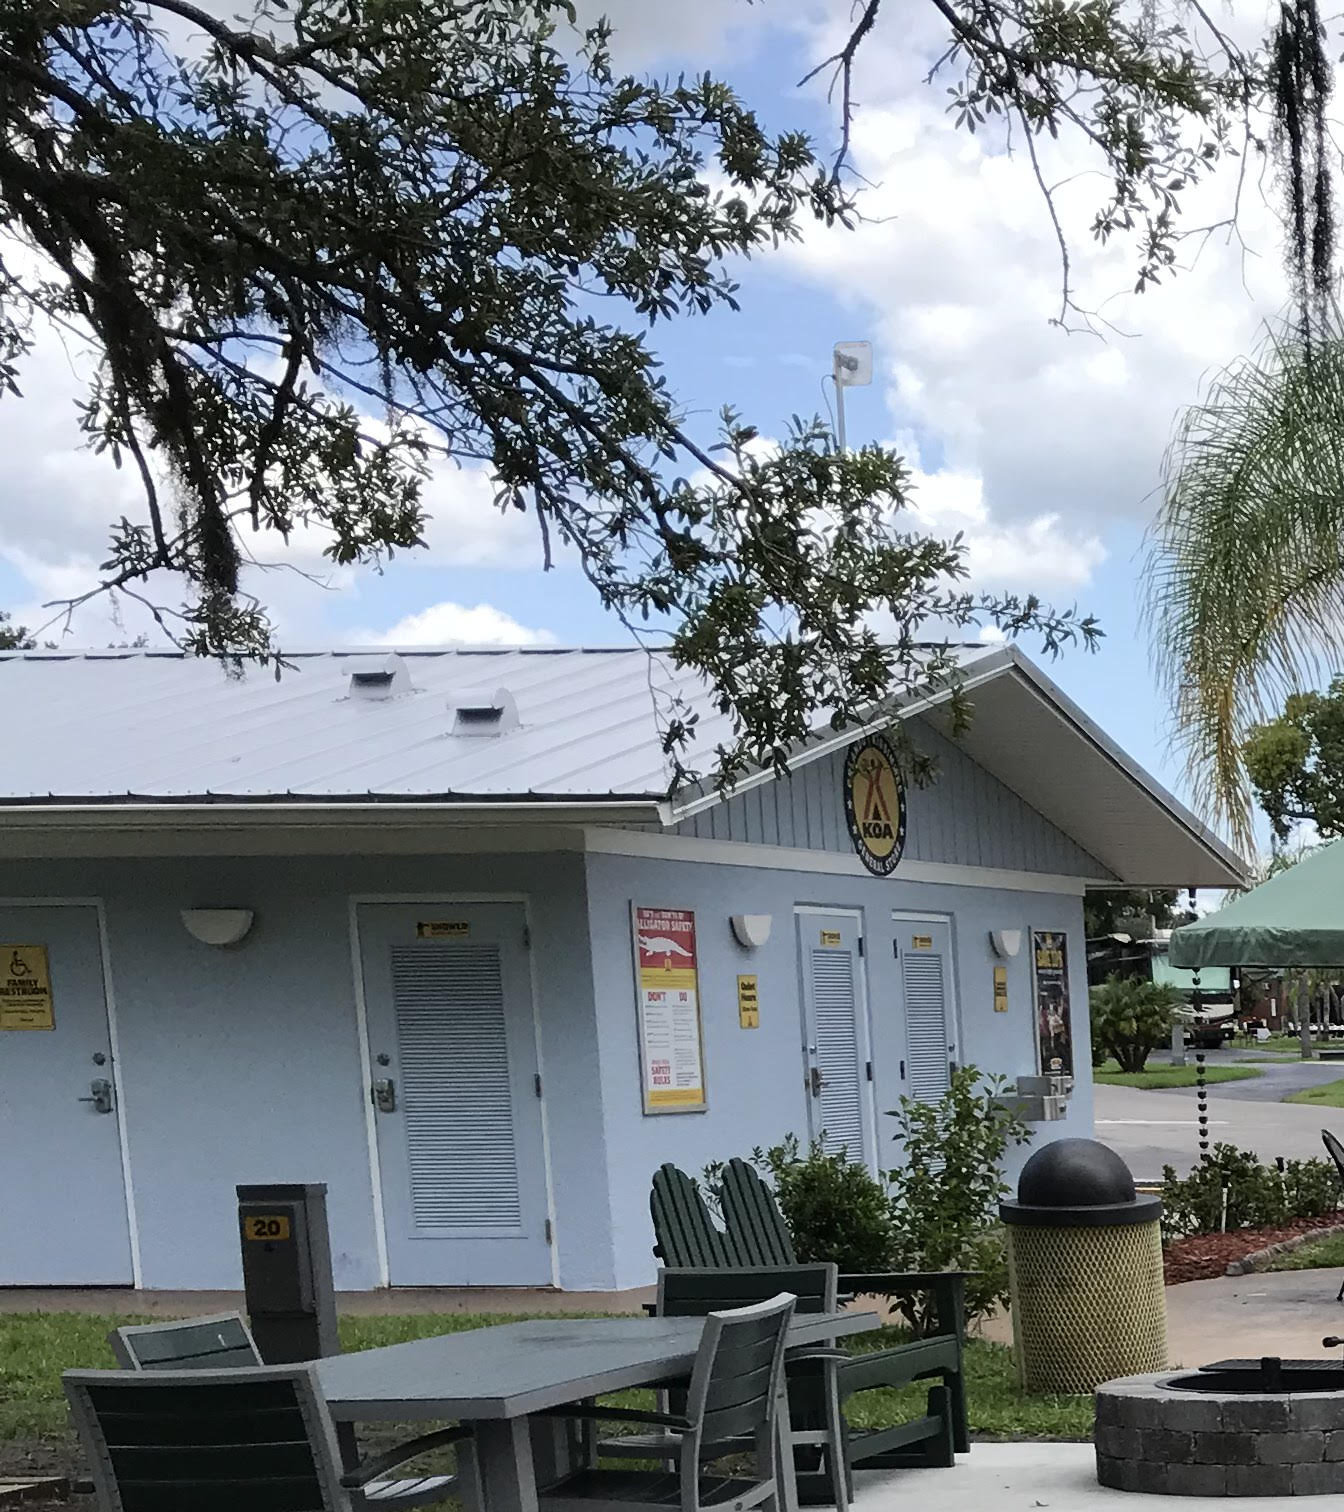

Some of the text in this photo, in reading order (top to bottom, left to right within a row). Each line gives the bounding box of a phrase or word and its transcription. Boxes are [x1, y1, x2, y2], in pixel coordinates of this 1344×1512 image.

[862, 821, 894, 839] KOA
[7, 979, 39, 987] FAMILY
[253, 1220, 281, 1236] 20
